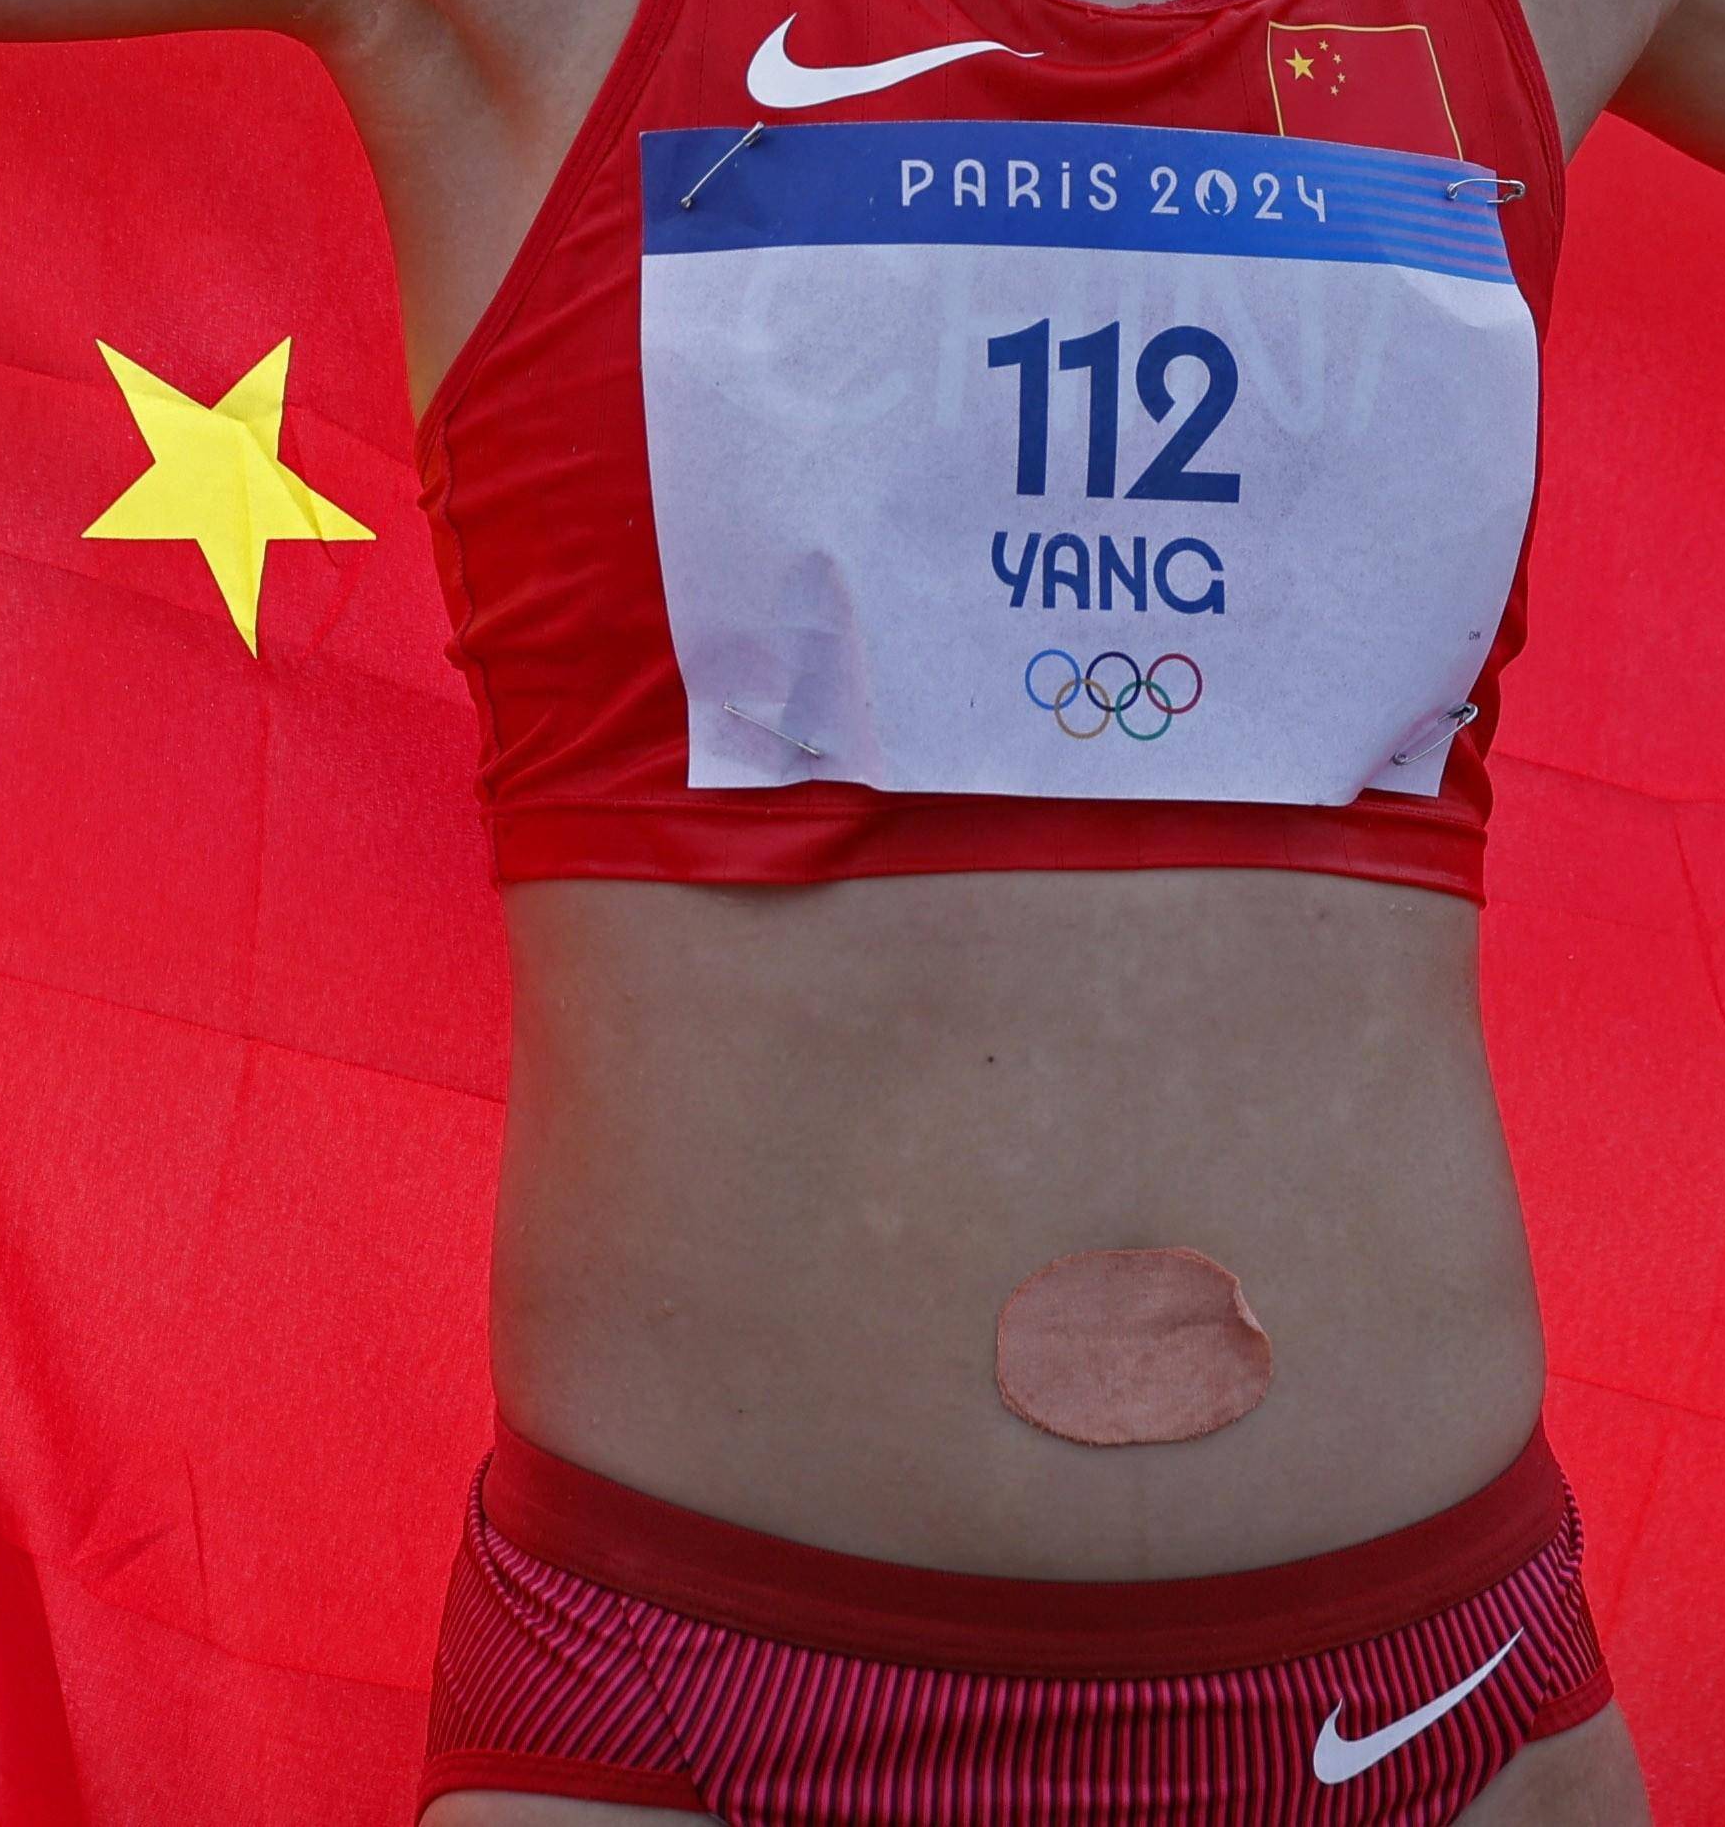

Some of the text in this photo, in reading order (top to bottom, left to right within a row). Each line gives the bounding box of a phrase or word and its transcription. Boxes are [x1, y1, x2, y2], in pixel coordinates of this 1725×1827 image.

[1149, 165, 1327, 224] 2024
[986, 316, 1243, 505] 112
[990, 529, 1227, 616] YANG
